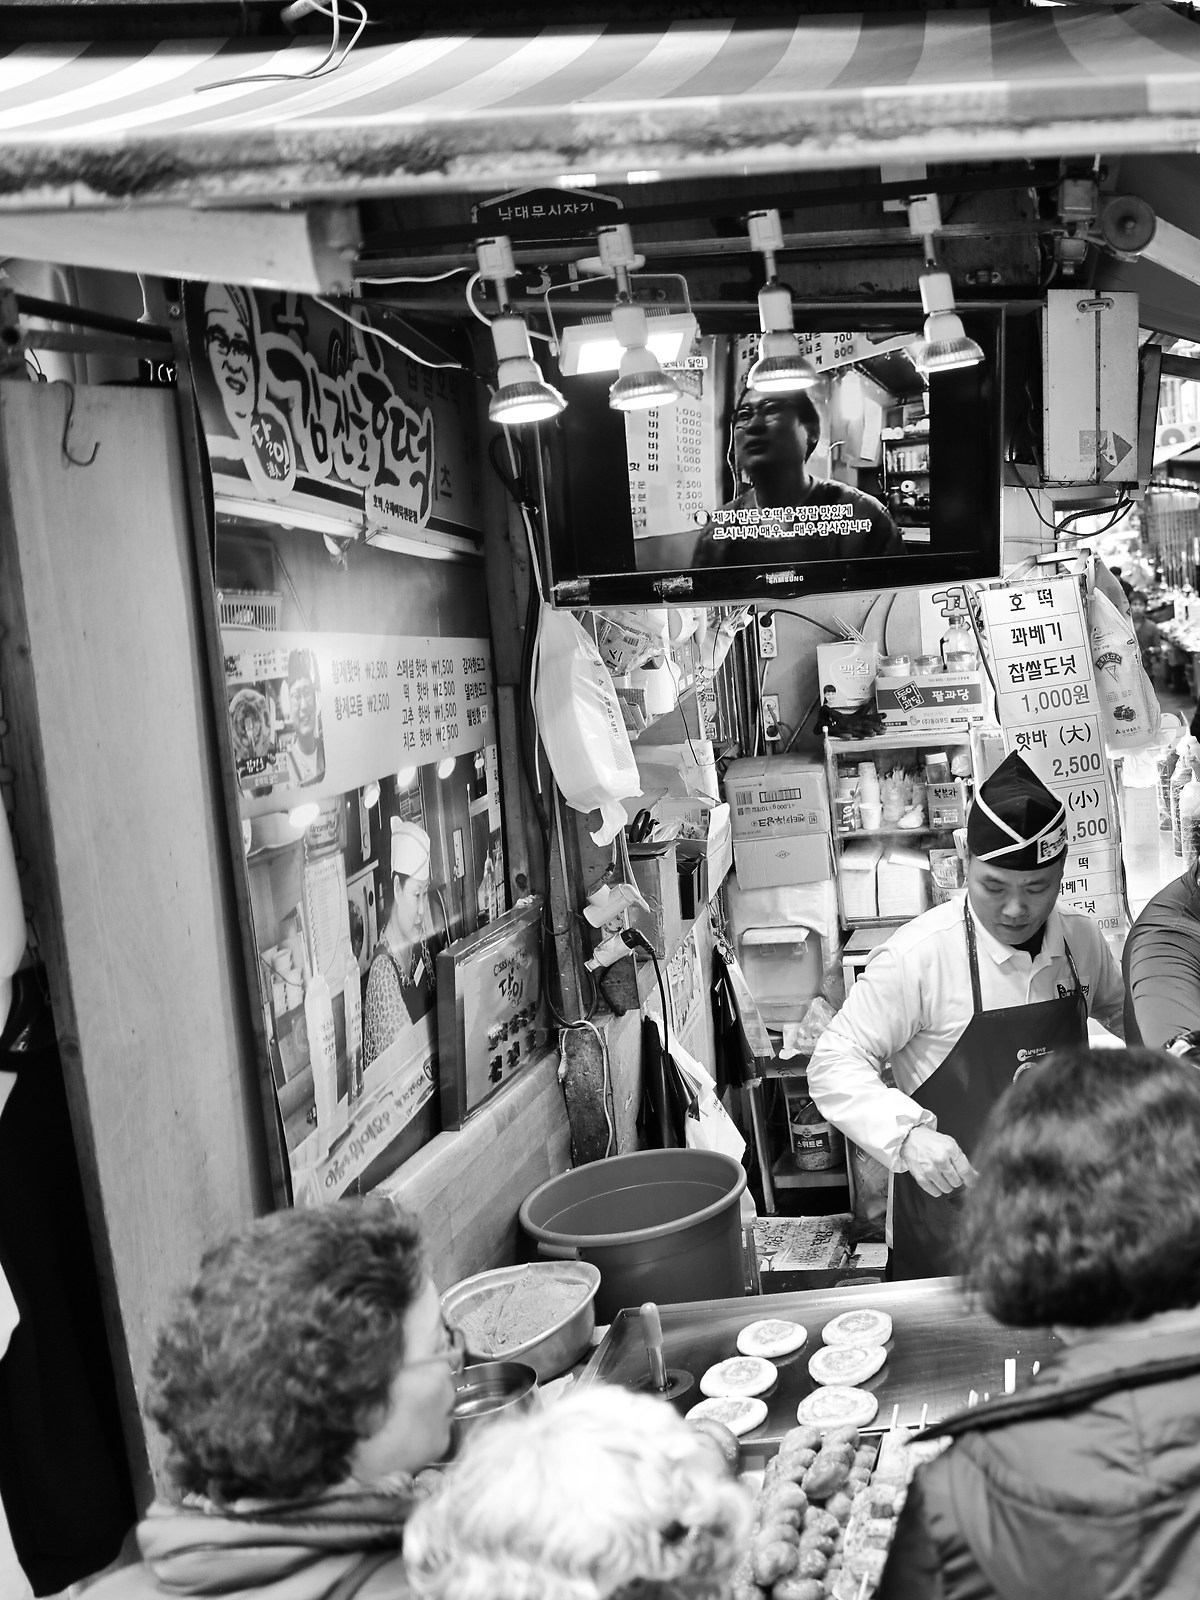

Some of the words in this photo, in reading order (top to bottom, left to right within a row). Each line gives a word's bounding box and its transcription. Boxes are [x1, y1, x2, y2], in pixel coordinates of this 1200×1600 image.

[688, 358, 704, 368] 달인
[834, 346, 854, 359] 800
[676, 481, 702, 490] 2,500
[677, 491, 702, 500] 2,500
[679, 502, 703, 512] 1,000
[712, 510, 736, 524] 제가
[737, 509, 760, 524] 만든
[761, 507, 795, 523] 호떡을
[796, 505, 819, 521] 정말
[820, 503, 853, 521] 맛있게
[713, 525, 758, 540] 드시니까
[818, 519, 872, 537] 감사합니다
[1011, 621, 1063, 647] 꽈베기
[331, 659, 361, 685] 황제핫바
[365, 660, 388, 680] ₩2,500
[397, 658, 415, 678] 스페셜
[415, 658, 428, 678] 핫바
[431, 659, 454, 677] ₩1,500
[463, 657, 486, 675] 감자핫도그
[839, 658, 871, 676] 맥심
[1008, 654, 1077, 683] 찹쌀도넛
[404, 683, 410, 700] 떡
[416, 682, 430, 702] 핫바
[1021, 684, 1090, 714] 1,000원
[335, 693, 363, 721] 황제모듬
[367, 693, 390, 714] ₩2,500
[402, 706, 415, 726] 고추
[418, 704, 431, 725] 핫바
[434, 702, 457, 724] ₩1,500
[403, 730, 416, 751] 치즈
[419, 728, 432, 747] 핫바
[1015, 729, 1047, 752] 핫바
[1059, 722, 1092, 746] (大)
[1052, 752, 1101, 778] 2,500
[934, 787, 958, 798] 복분자
[1068, 788, 1100, 812] (小)
[1070, 817, 1108, 842] ,500
[1078, 856, 1089, 870] 떡
